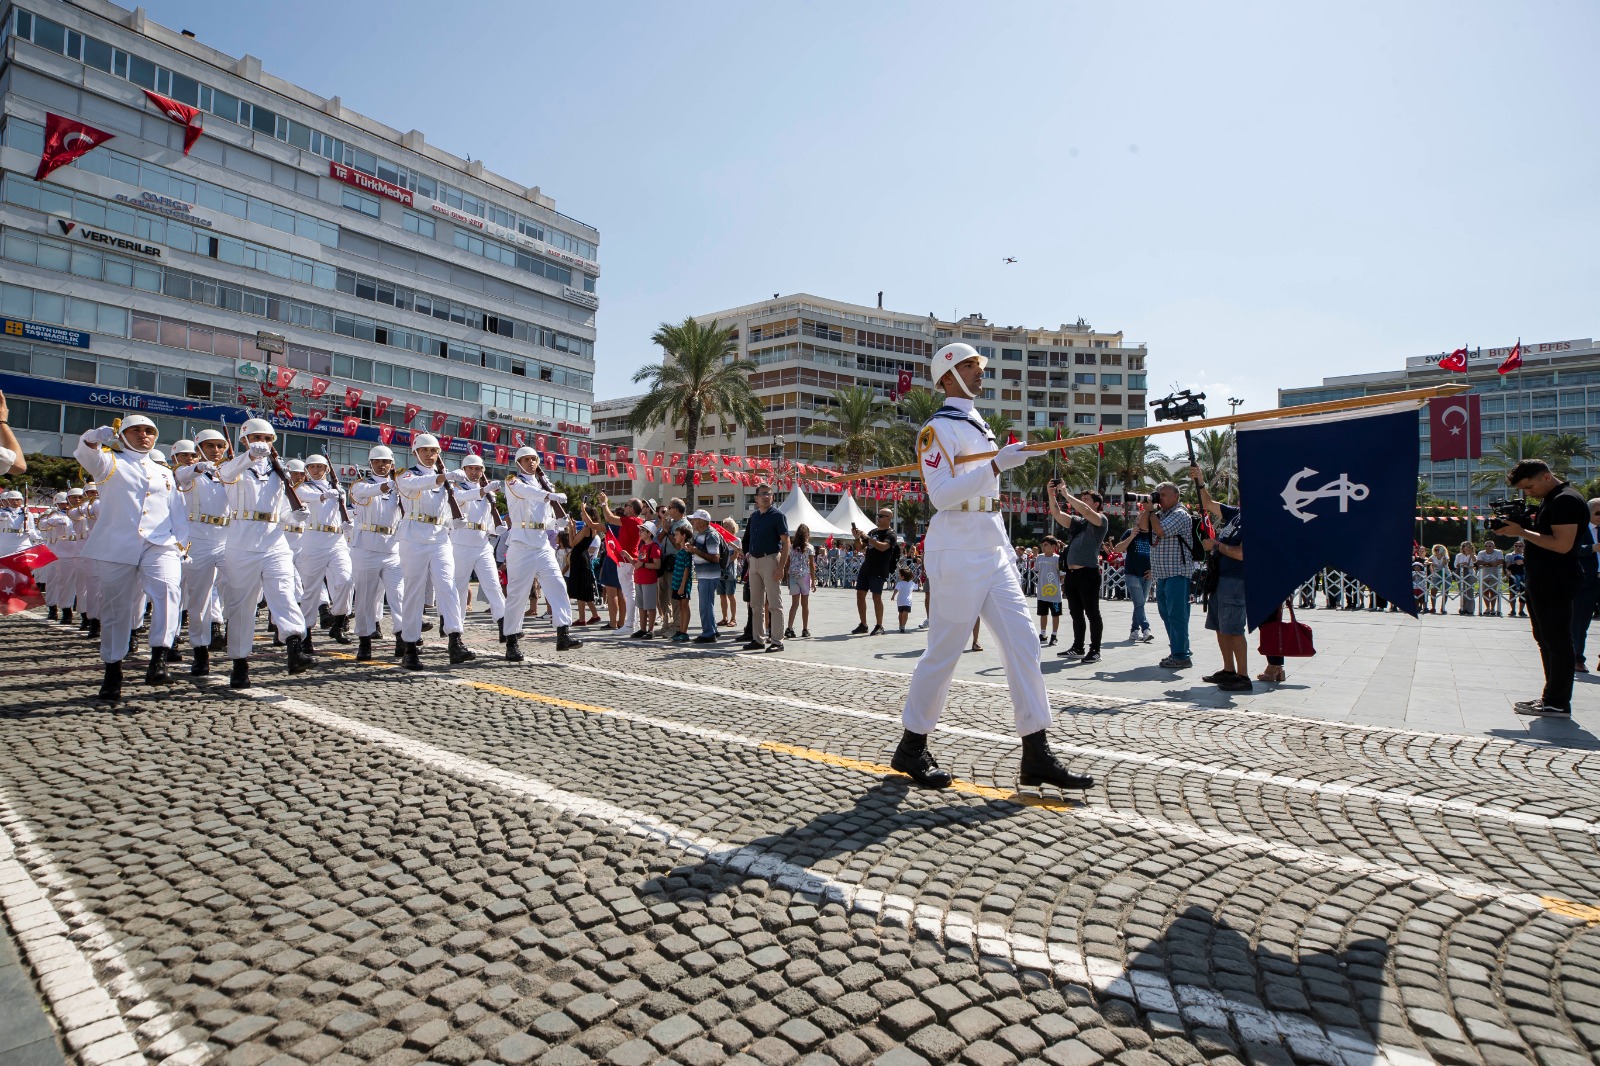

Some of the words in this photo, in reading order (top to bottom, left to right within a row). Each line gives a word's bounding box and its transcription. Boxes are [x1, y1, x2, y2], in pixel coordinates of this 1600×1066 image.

[353, 172, 411, 204] TürkMedya
[24, 323, 52, 333] BARTH
[1539, 341, 1571, 352] EFES
[341, 466, 372, 478] LÖSE
